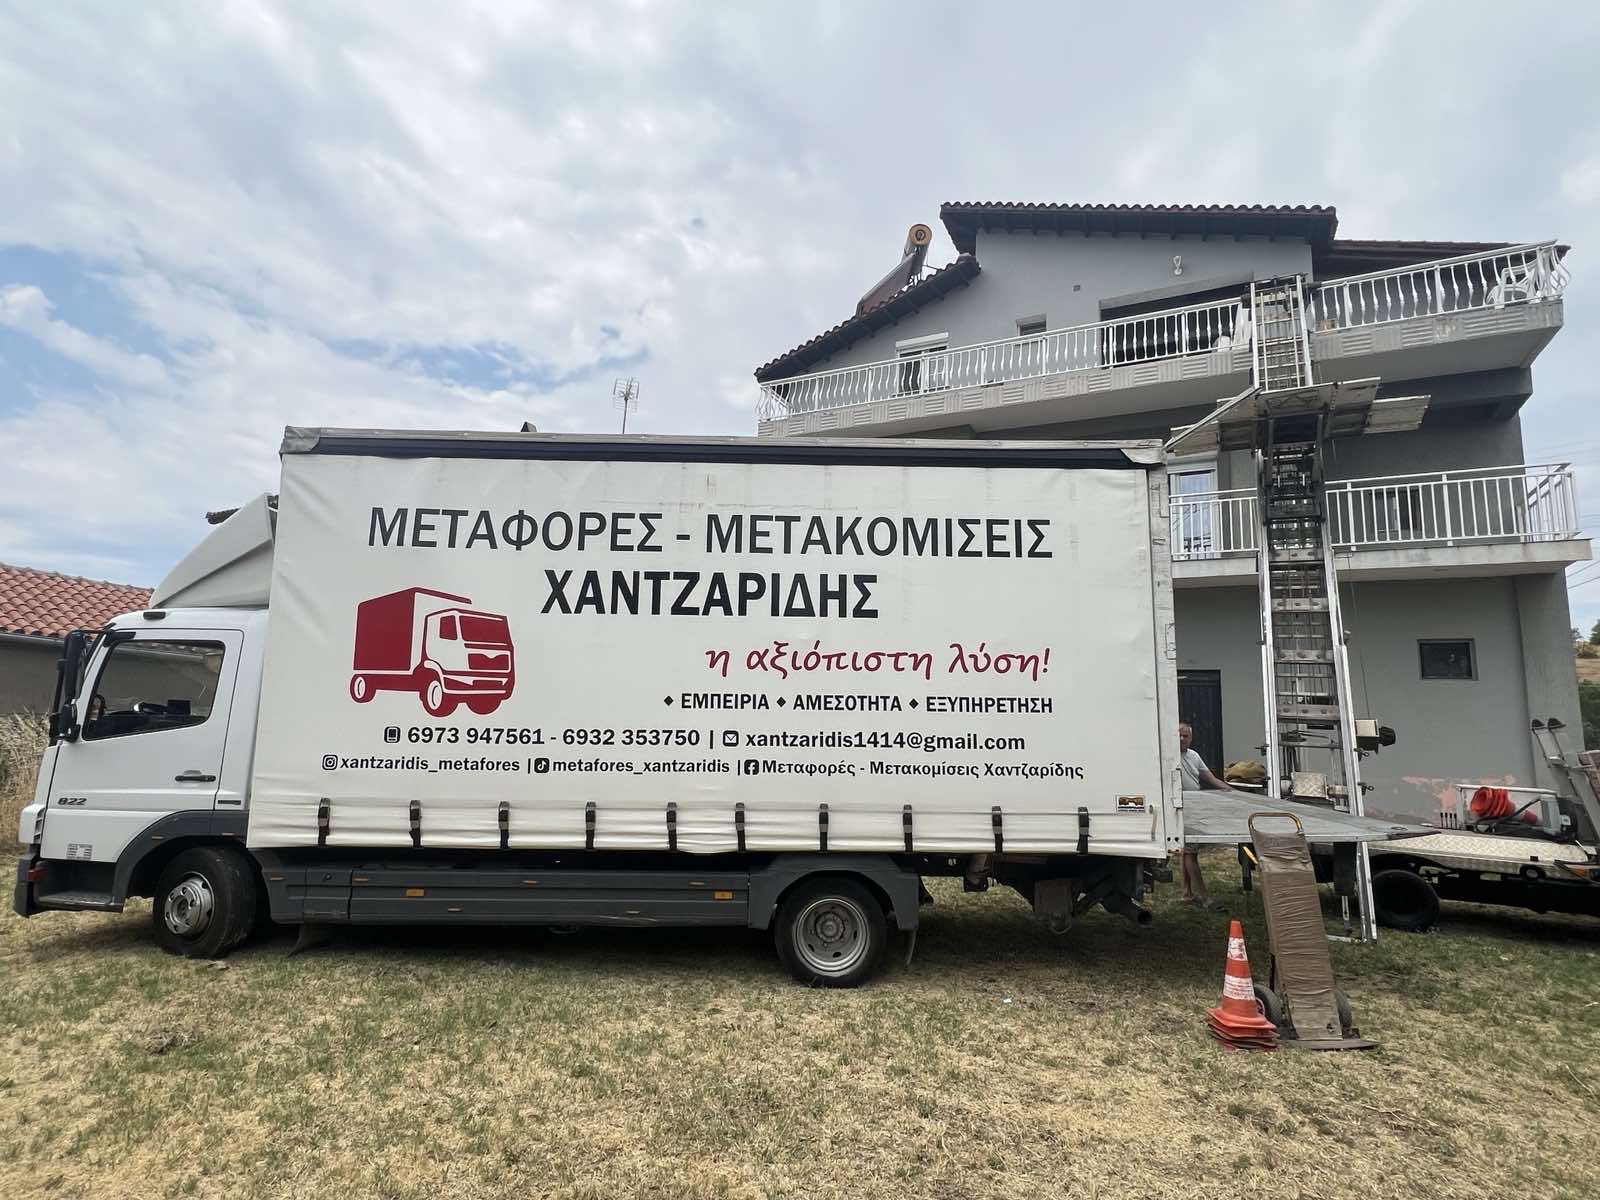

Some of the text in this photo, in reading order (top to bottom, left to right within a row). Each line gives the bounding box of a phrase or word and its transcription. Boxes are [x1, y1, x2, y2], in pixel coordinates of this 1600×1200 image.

[368, 506, 663, 552] ΜΕΤΑΦΟΡΕΣ
[706, 513, 1053, 559] ΜΕΤΑΚΟΜΙΣΕΙΣ
[540, 569, 879, 619] ΧΑΝΤΖΑΡΙΔΗΣ
[705, 639, 1051, 682] η αξιόπιστη λύση!
[681, 692, 1053, 714] ΕΜΠΕΙΡΙΑ ΑΜΕΣΟΤΗΤΑ ΕΞΥΠΗΡΕΤΗΣΗ
[407, 726, 460, 744] 6973
[466, 727, 545, 745] 947561
[562, 728, 615, 746] 6932
[621, 729, 700, 746] 353750
[745, 731, 1025, 753] xantzaridis1414@gmail.com
[339, 756, 520, 773] xantzaridis_metafores
[552, 758, 730, 775] metafores_xantzaridis
[762, 759, 856, 777] Μεταφορές
[869, 761, 980, 779] Μετακομίσεις
[983, 762, 1084, 780] Χαντζαρίδης
